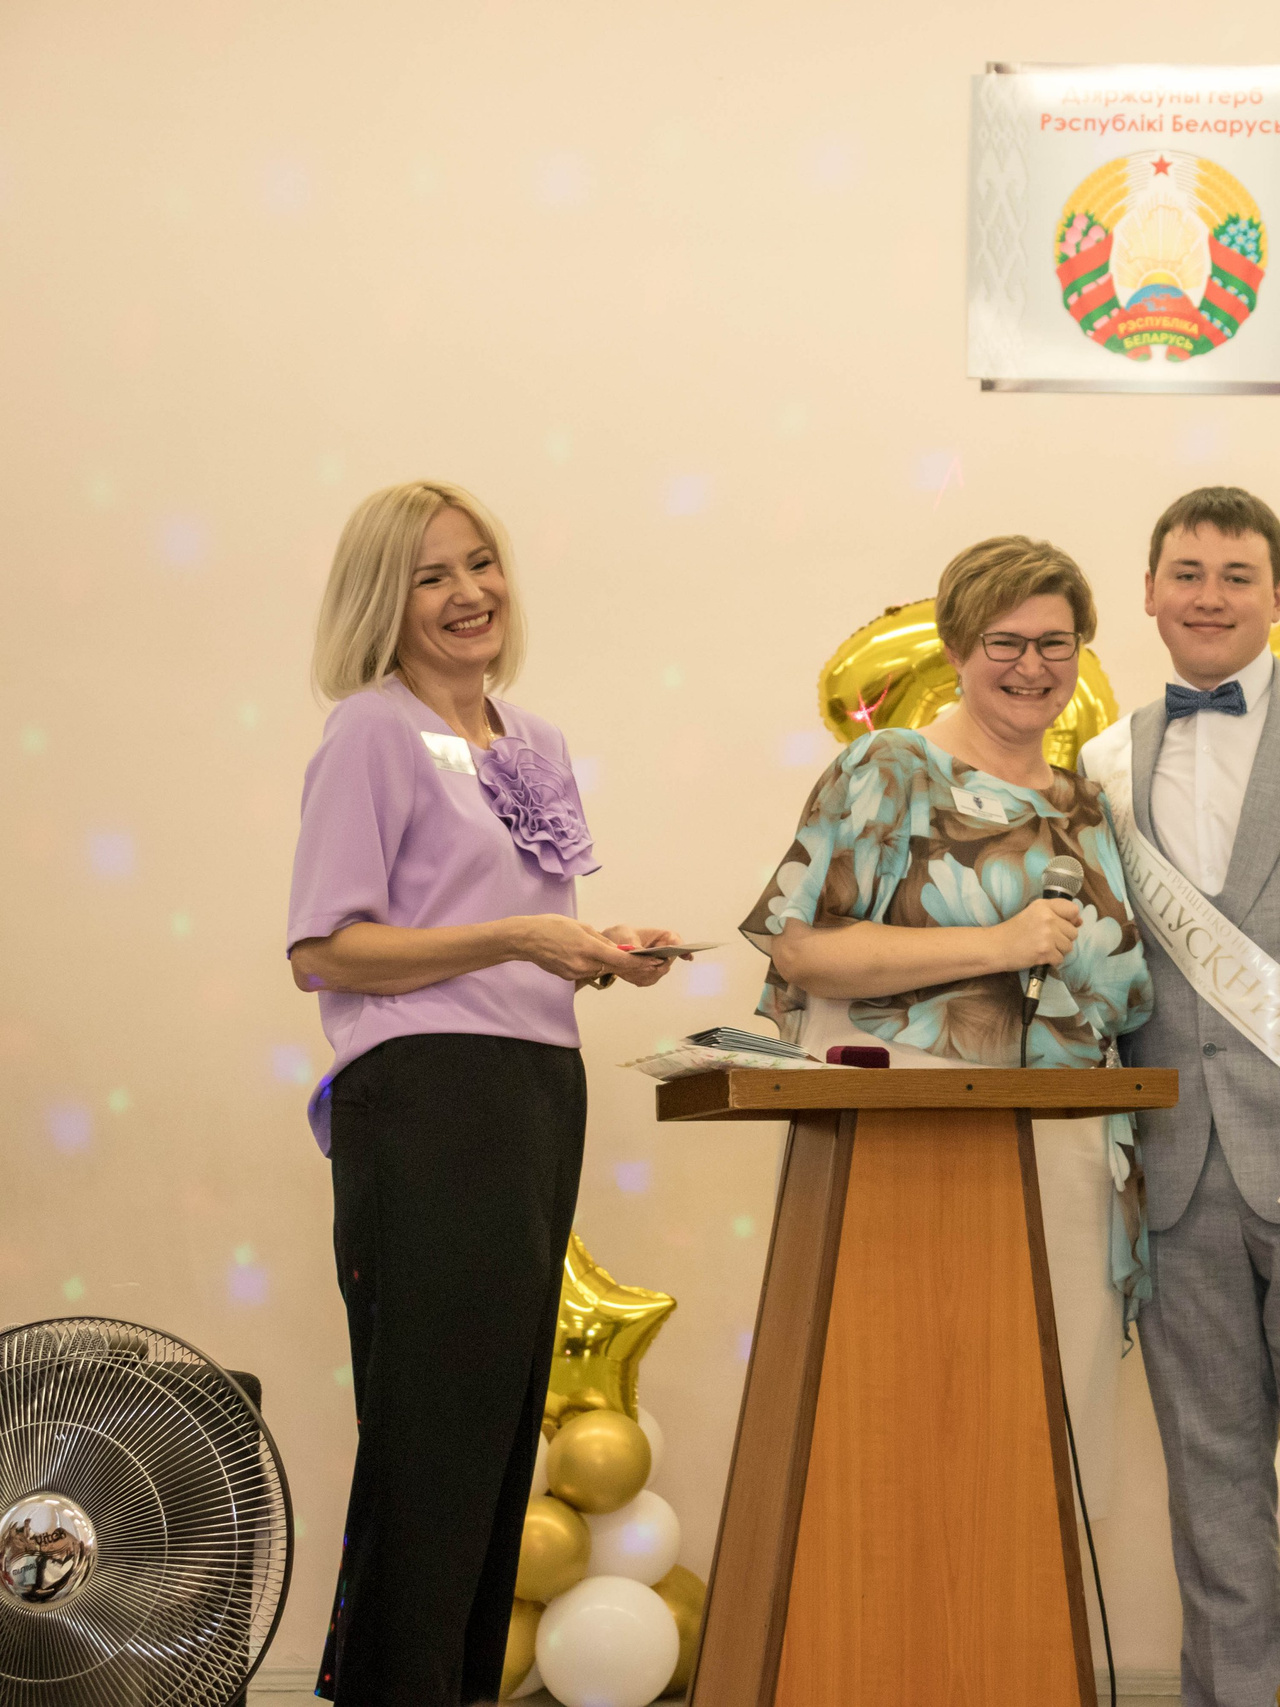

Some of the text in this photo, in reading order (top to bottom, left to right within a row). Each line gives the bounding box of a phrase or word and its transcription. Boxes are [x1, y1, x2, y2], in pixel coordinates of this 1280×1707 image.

[1208, 87, 1264, 109] герб
[1040, 113, 1164, 136] Рэспублікі
[1117, 316, 1199, 334] РЭСПУБЛІКА
[1123, 332, 1194, 351] БЕЛАРУСЬ
